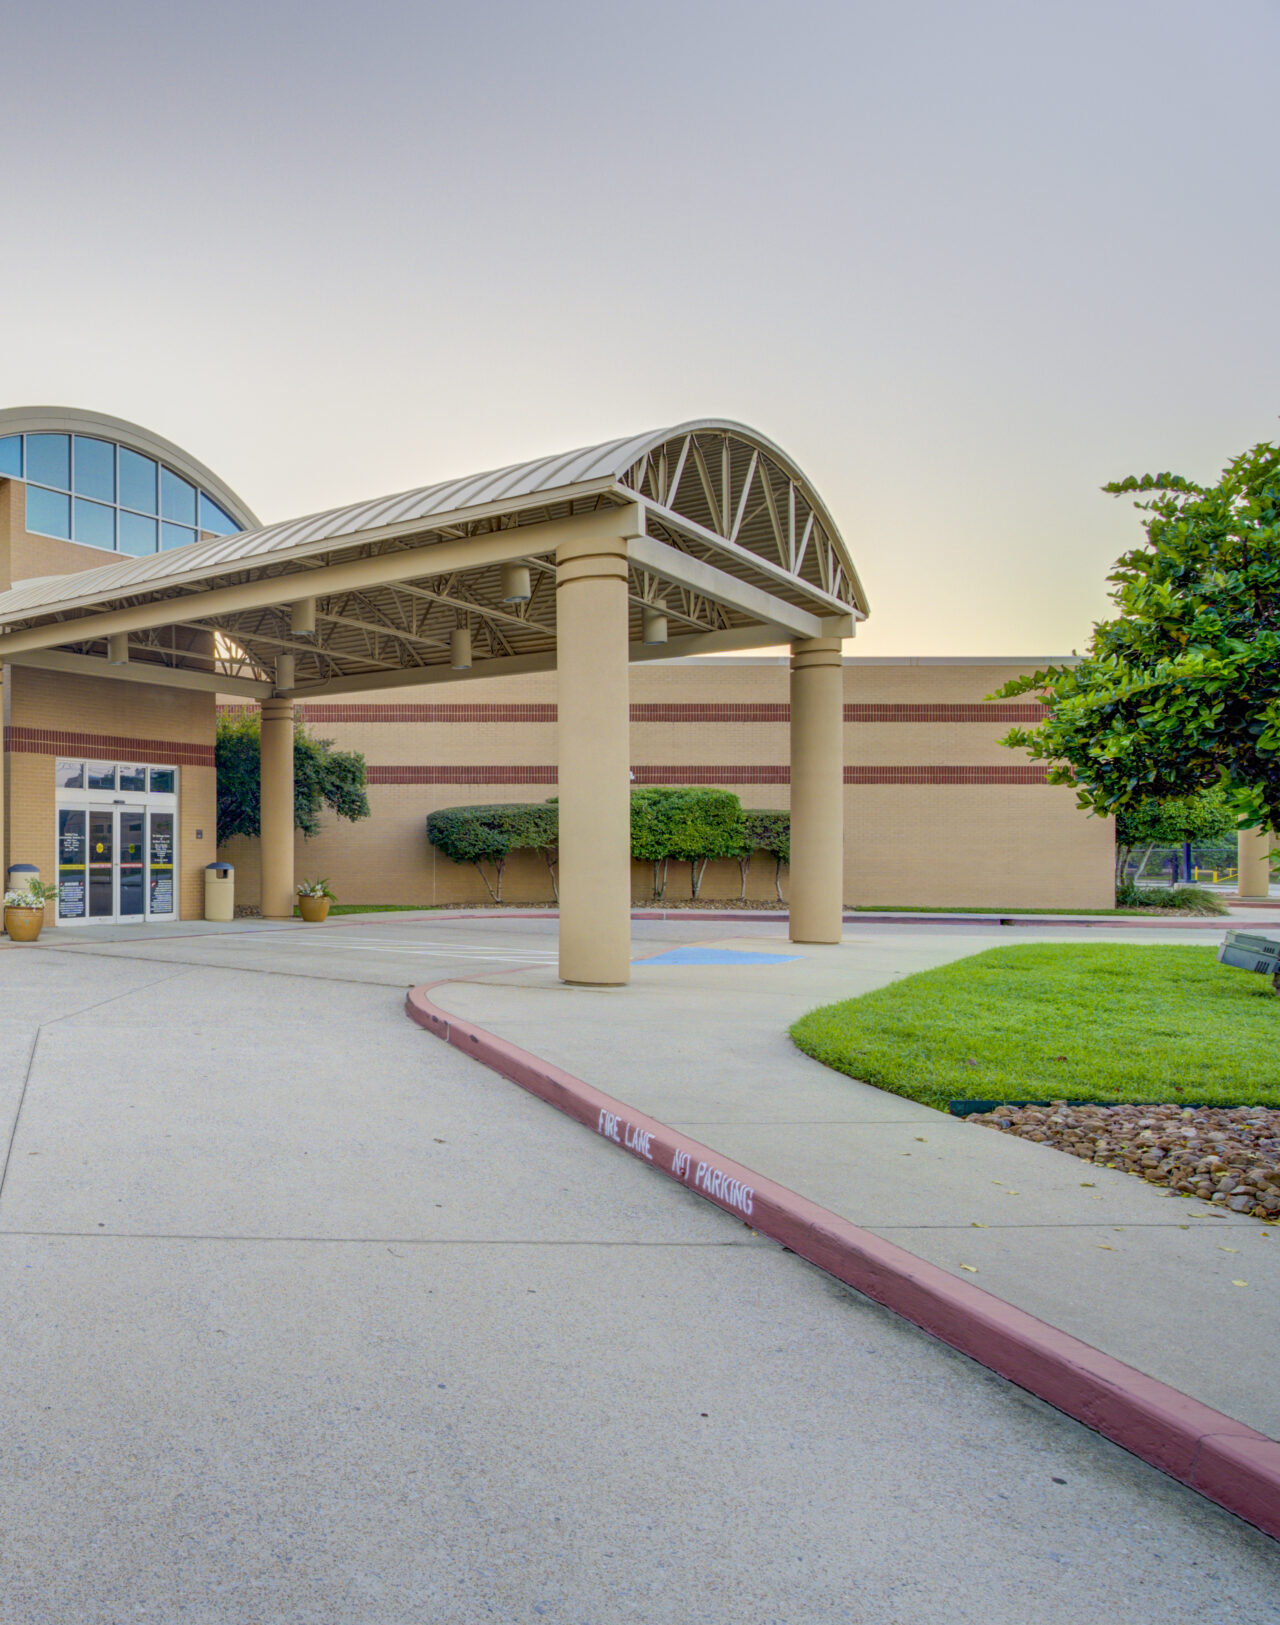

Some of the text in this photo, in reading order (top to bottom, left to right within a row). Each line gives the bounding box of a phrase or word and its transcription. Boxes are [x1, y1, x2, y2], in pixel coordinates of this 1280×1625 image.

[598, 1108, 755, 1215] FIRE LANE NO PARKING
